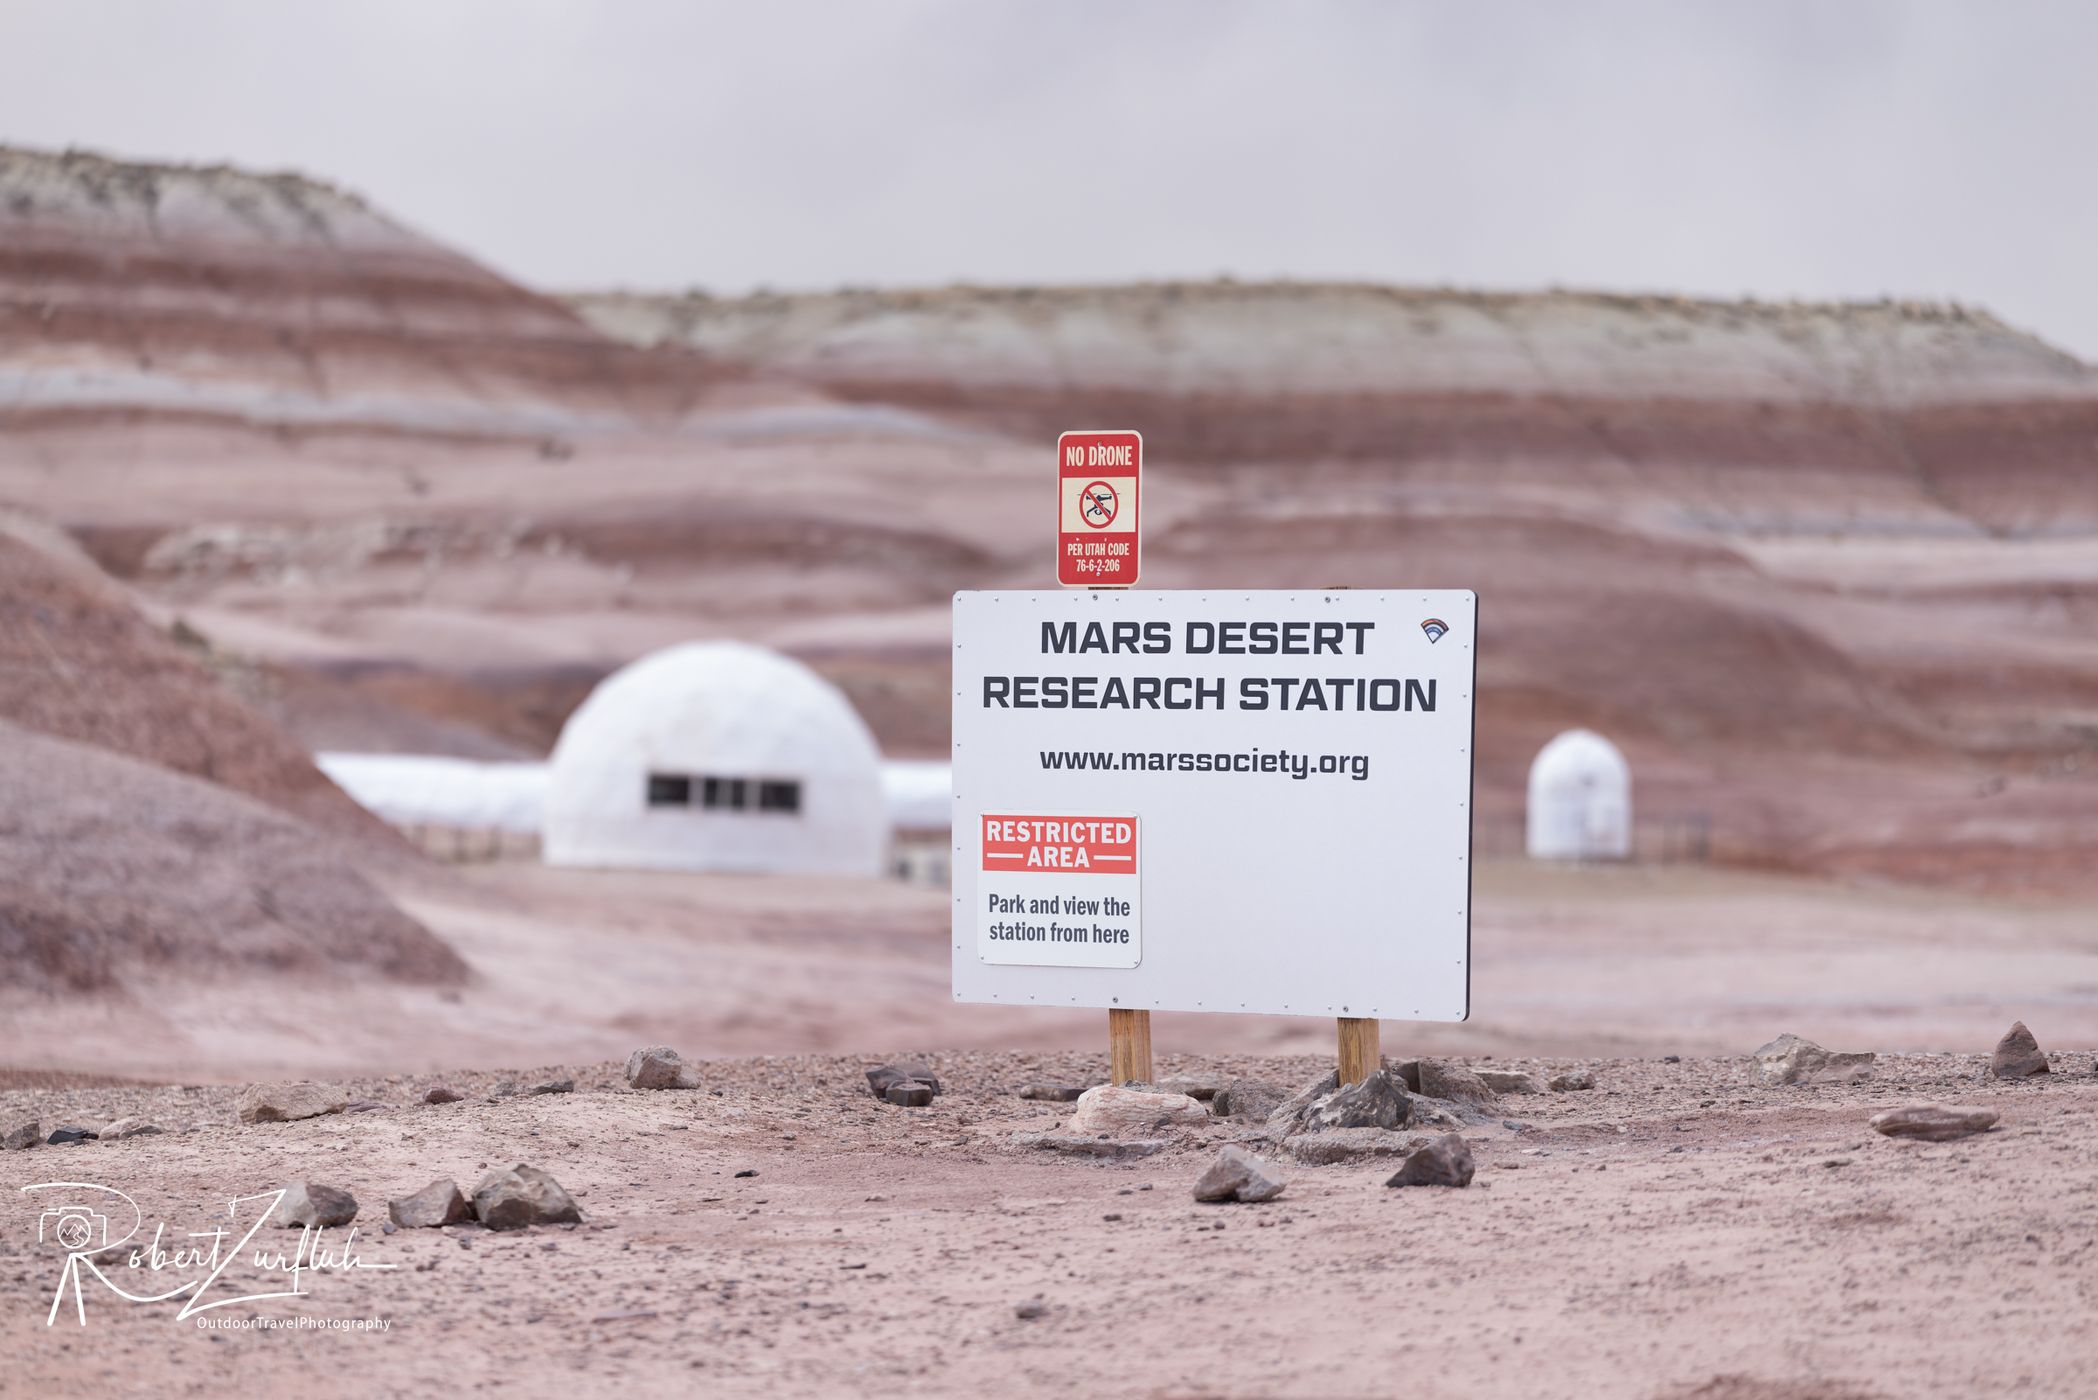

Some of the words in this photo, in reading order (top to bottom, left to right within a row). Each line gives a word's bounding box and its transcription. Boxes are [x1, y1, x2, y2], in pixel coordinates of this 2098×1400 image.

[1066, 446, 1085, 467] NO
[1088, 445, 1133, 466] DRONE
[1067, 543, 1083, 556] PER
[1085, 543, 1106, 556] UTAH
[1108, 543, 1130, 556] CODE
[1076, 559, 1120, 572] 76-6-2-206
[1041, 621, 1172, 654] MARS
[1185, 621, 1375, 655] DESERT
[983, 676, 1225, 710] RESEARCH
[1239, 678, 1437, 712] STATION
[1040, 748, 1370, 781] www.marssociety.org
[986, 820, 1132, 844] RESTRICTED
[1026, 846, 1090, 868] AREA
[989, 893, 1026, 914] Park
[1029, 895, 1060, 915] and
[1063, 896, 1100, 916] view
[1103, 897, 1131, 917] the
[989, 922, 1046, 942] station
[1050, 922, 1088, 943] from
[1092, 924, 1130, 944] here
